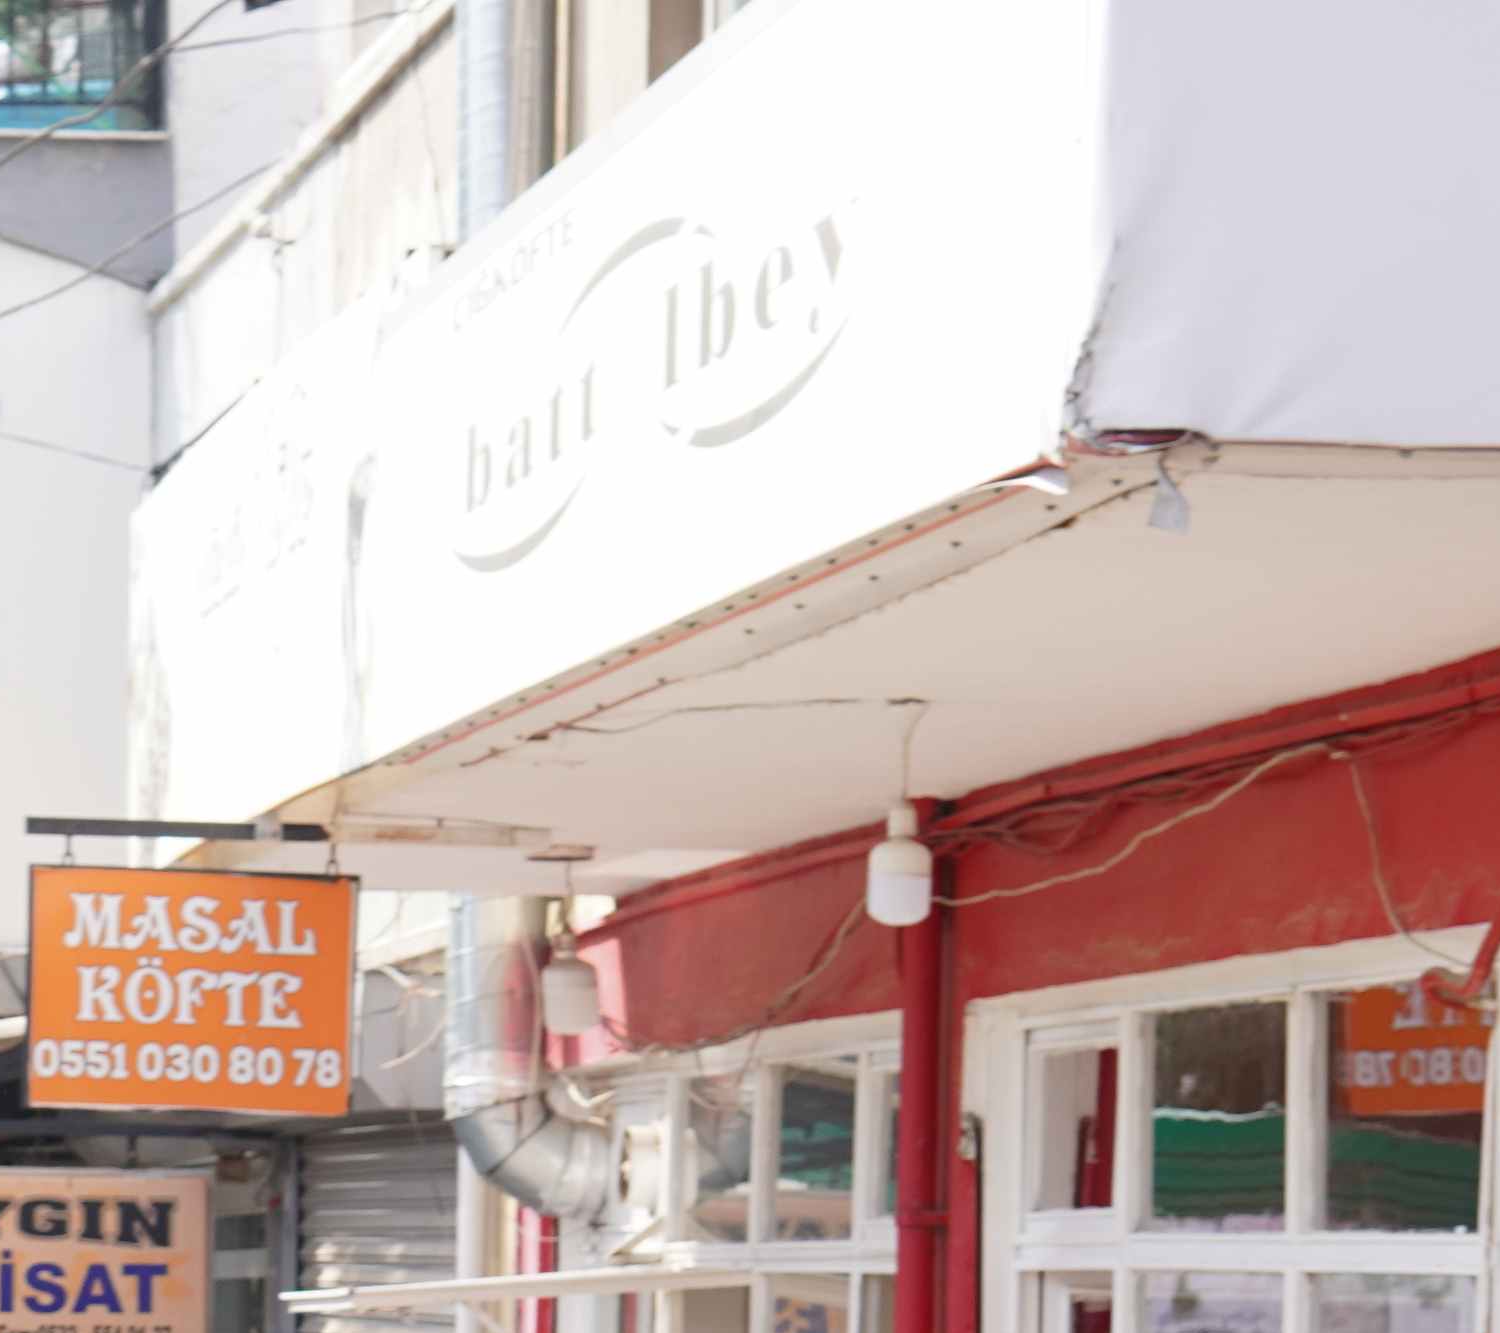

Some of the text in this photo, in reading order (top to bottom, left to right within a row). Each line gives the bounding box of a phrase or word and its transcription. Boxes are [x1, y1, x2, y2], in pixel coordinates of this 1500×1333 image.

[63, 892, 317, 956] MASAL
[75, 957, 303, 1029] KÖFTE
[32, 1038, 342, 1089] 0551 030 80 78
